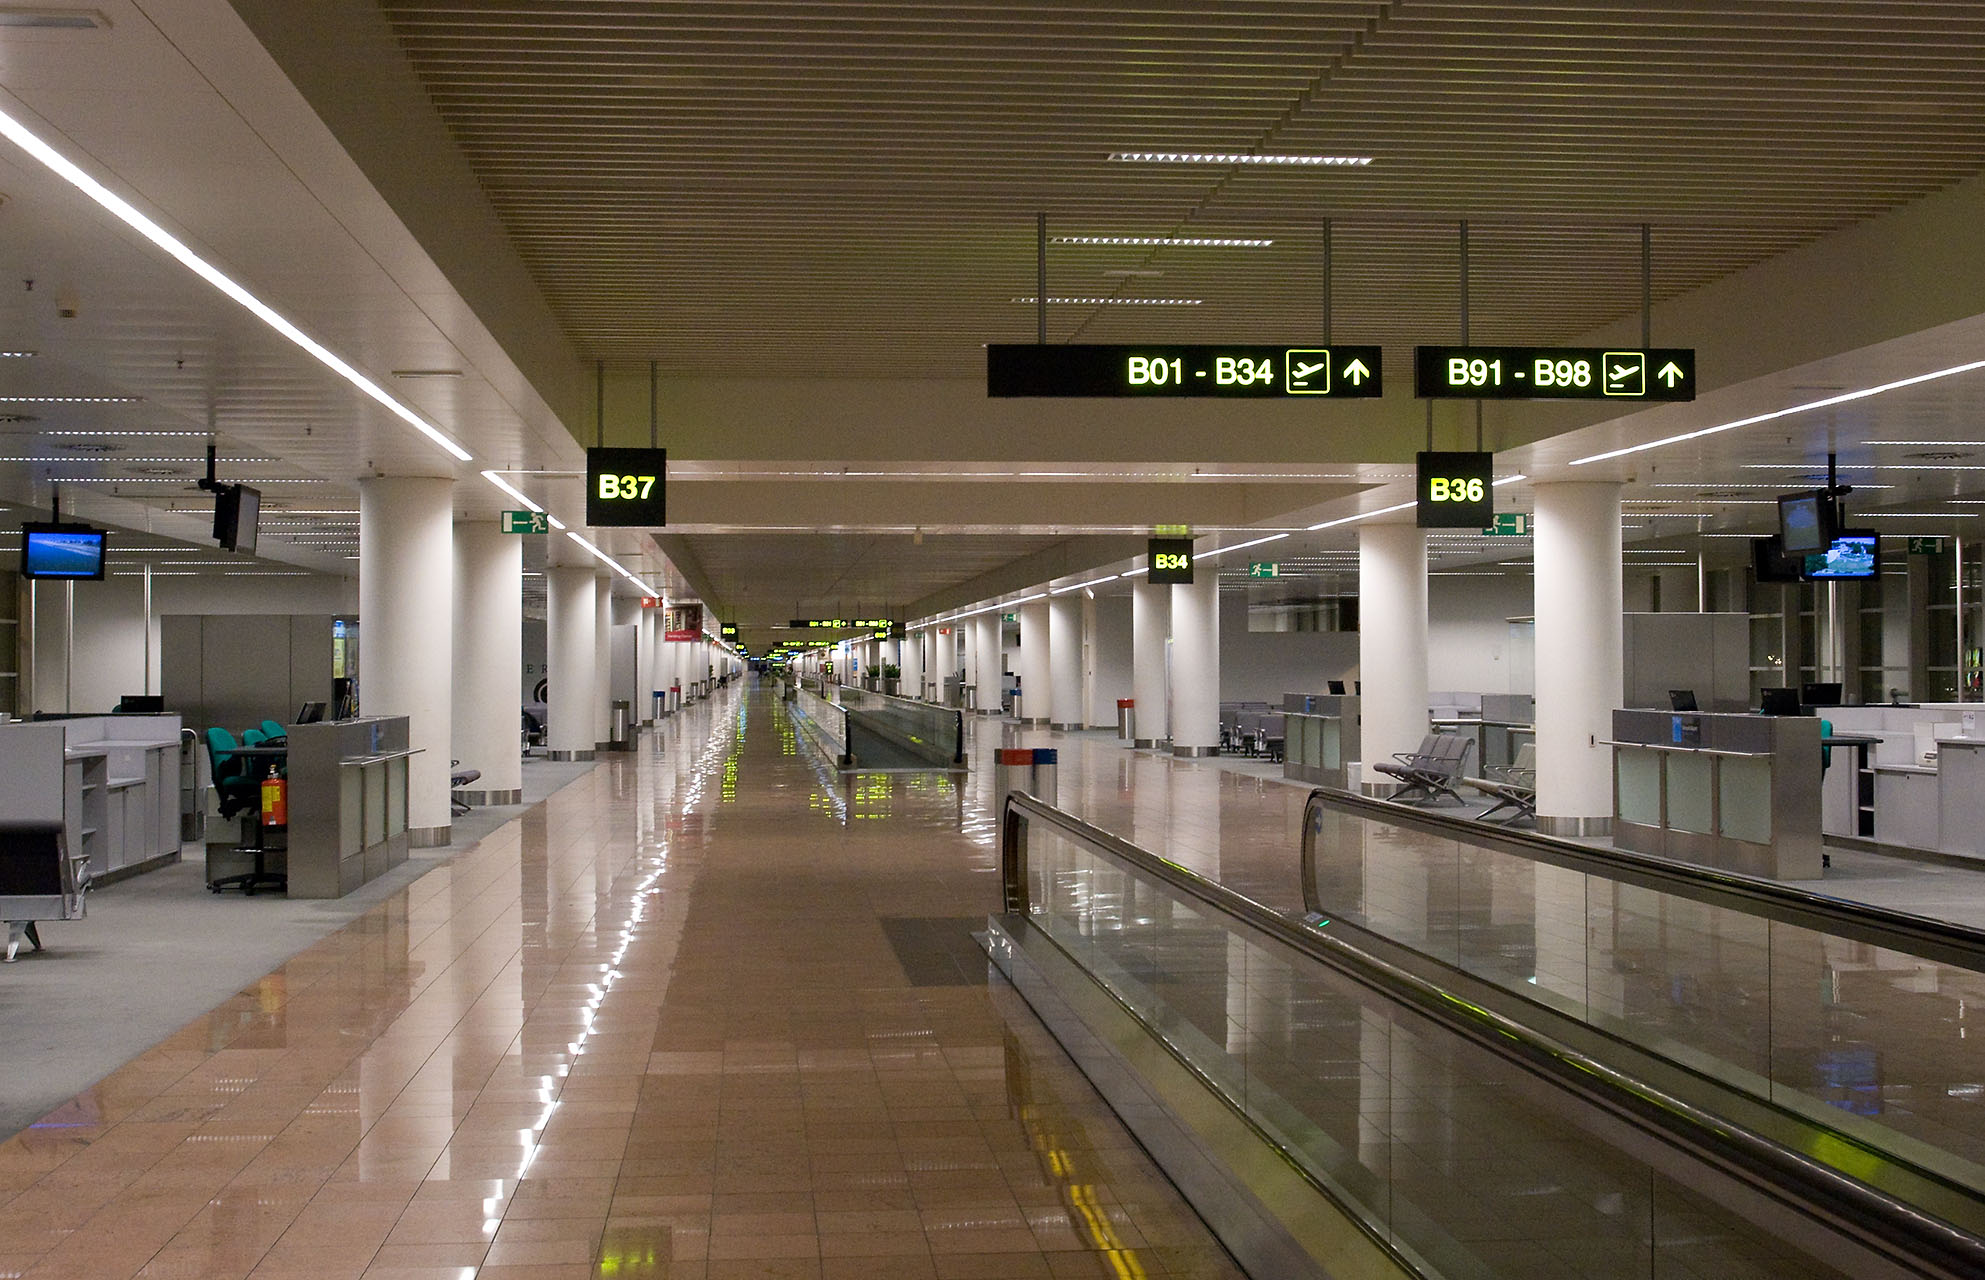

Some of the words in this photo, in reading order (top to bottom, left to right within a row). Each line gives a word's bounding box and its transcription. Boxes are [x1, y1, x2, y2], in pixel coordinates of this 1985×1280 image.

[1127, 356, 1183, 386] B01
[1195, 370, 1207, 378] -
[1215, 356, 1275, 386] B34
[1448, 357, 1502, 387] B91
[1514, 371, 1526, 379] -
[1534, 358, 1592, 388] B98
[598, 473, 657, 500] B37
[1430, 477, 1485, 503] B36
[1155, 553, 1189, 570] B34
